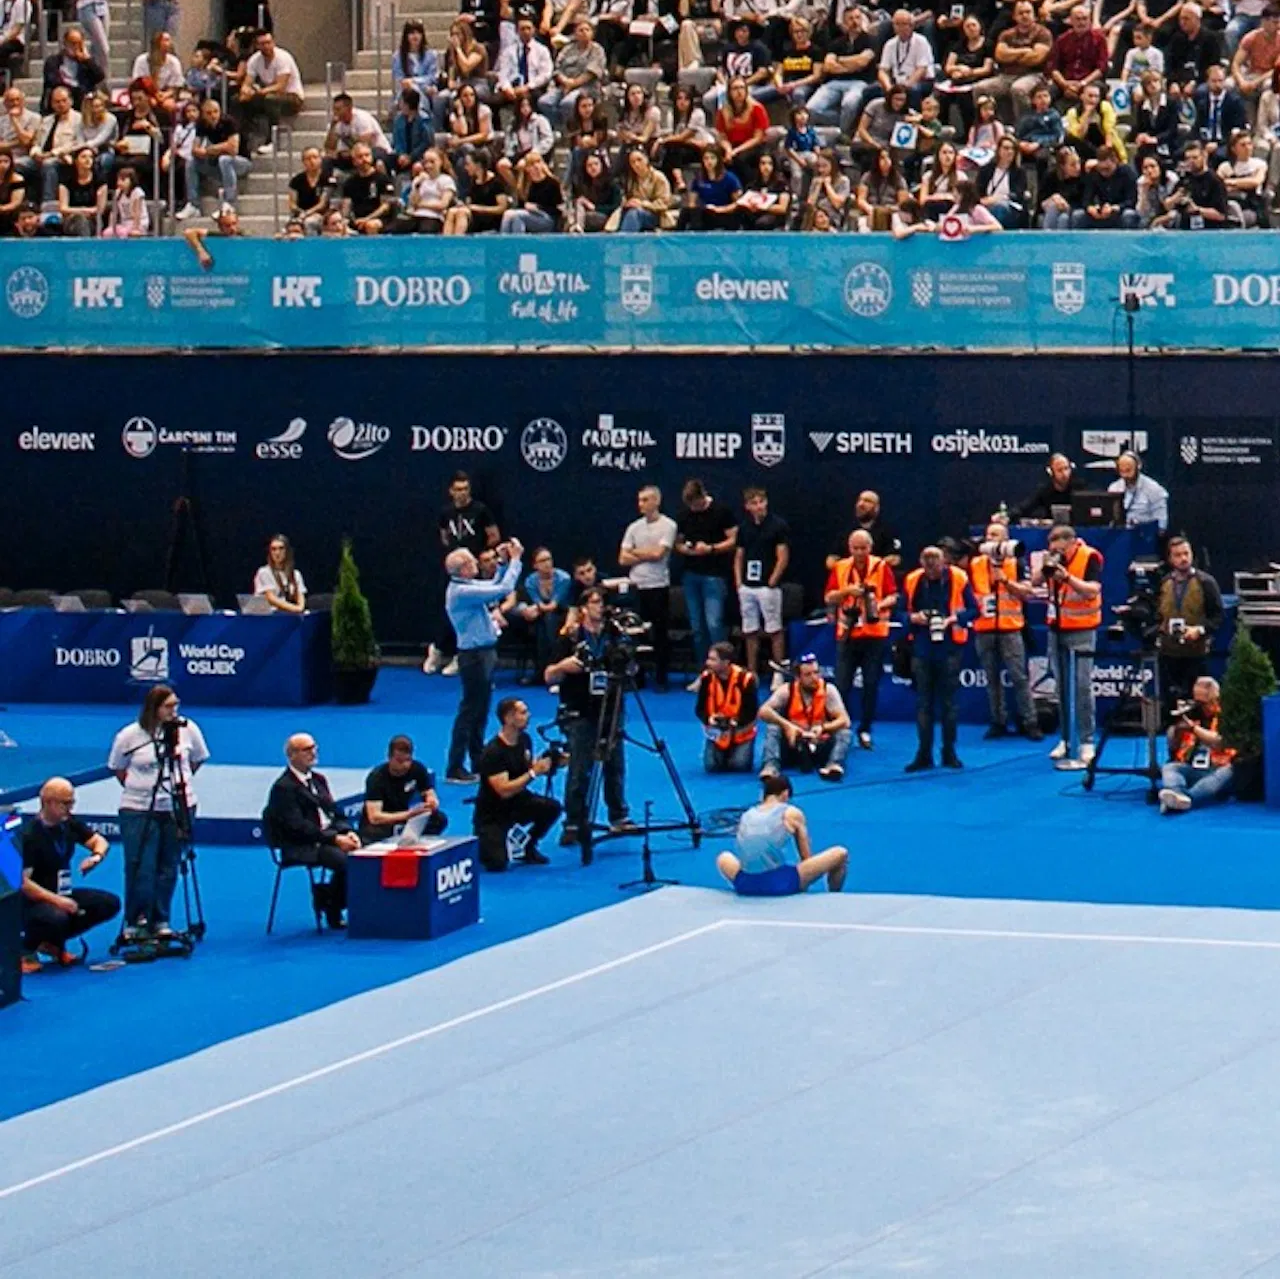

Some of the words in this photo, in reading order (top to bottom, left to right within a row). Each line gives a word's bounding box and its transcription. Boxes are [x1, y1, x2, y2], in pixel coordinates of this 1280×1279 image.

[355, 275, 471, 306] DOBRO
[499, 270, 590, 294] CROATIA
[411, 425, 503, 452] DOBRO
[582, 429, 657, 448] CROATIA
[835, 432, 912, 454] SPIETH
[931, 429, 1050, 457] osijek031.com
[256, 441, 303, 459] esse
[55, 648, 120, 666] DOBRO
[179, 644, 217, 659] World
[219, 645, 244, 661] Cup
[187, 660, 236, 675] OSIJEK
[437, 858, 473, 893] DWC
